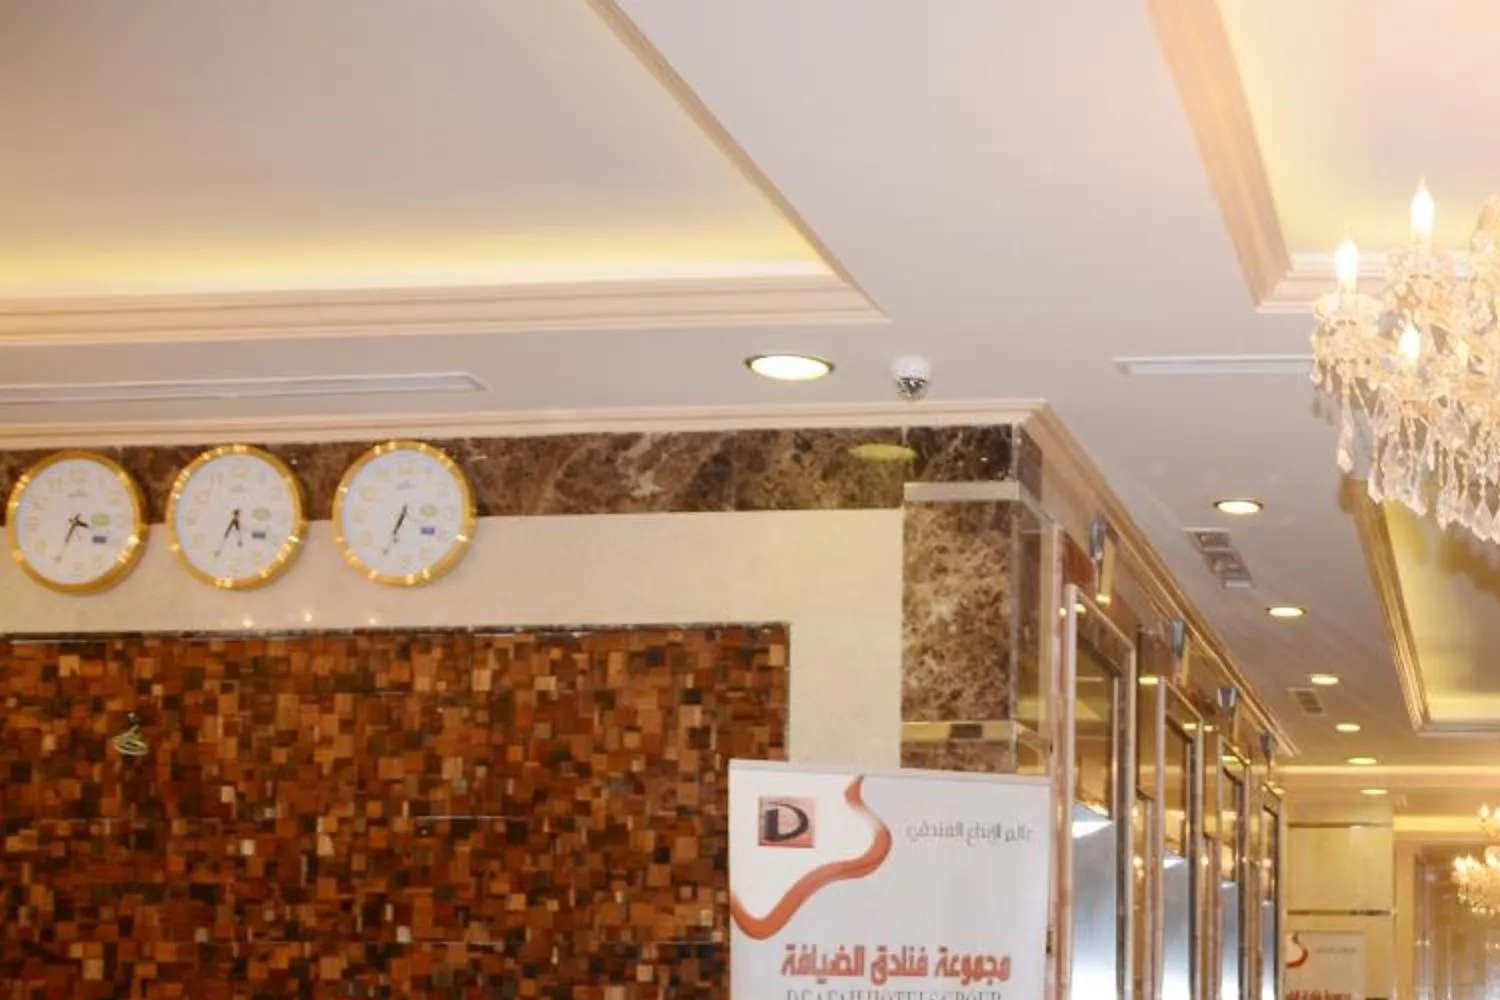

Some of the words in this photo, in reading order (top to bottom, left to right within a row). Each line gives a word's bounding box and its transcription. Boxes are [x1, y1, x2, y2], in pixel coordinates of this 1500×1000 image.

[779, 942, 866, 984] الضيافة
[870, 943, 930, 985] فنادق
[934, 945, 1012, 986] مجموعة
